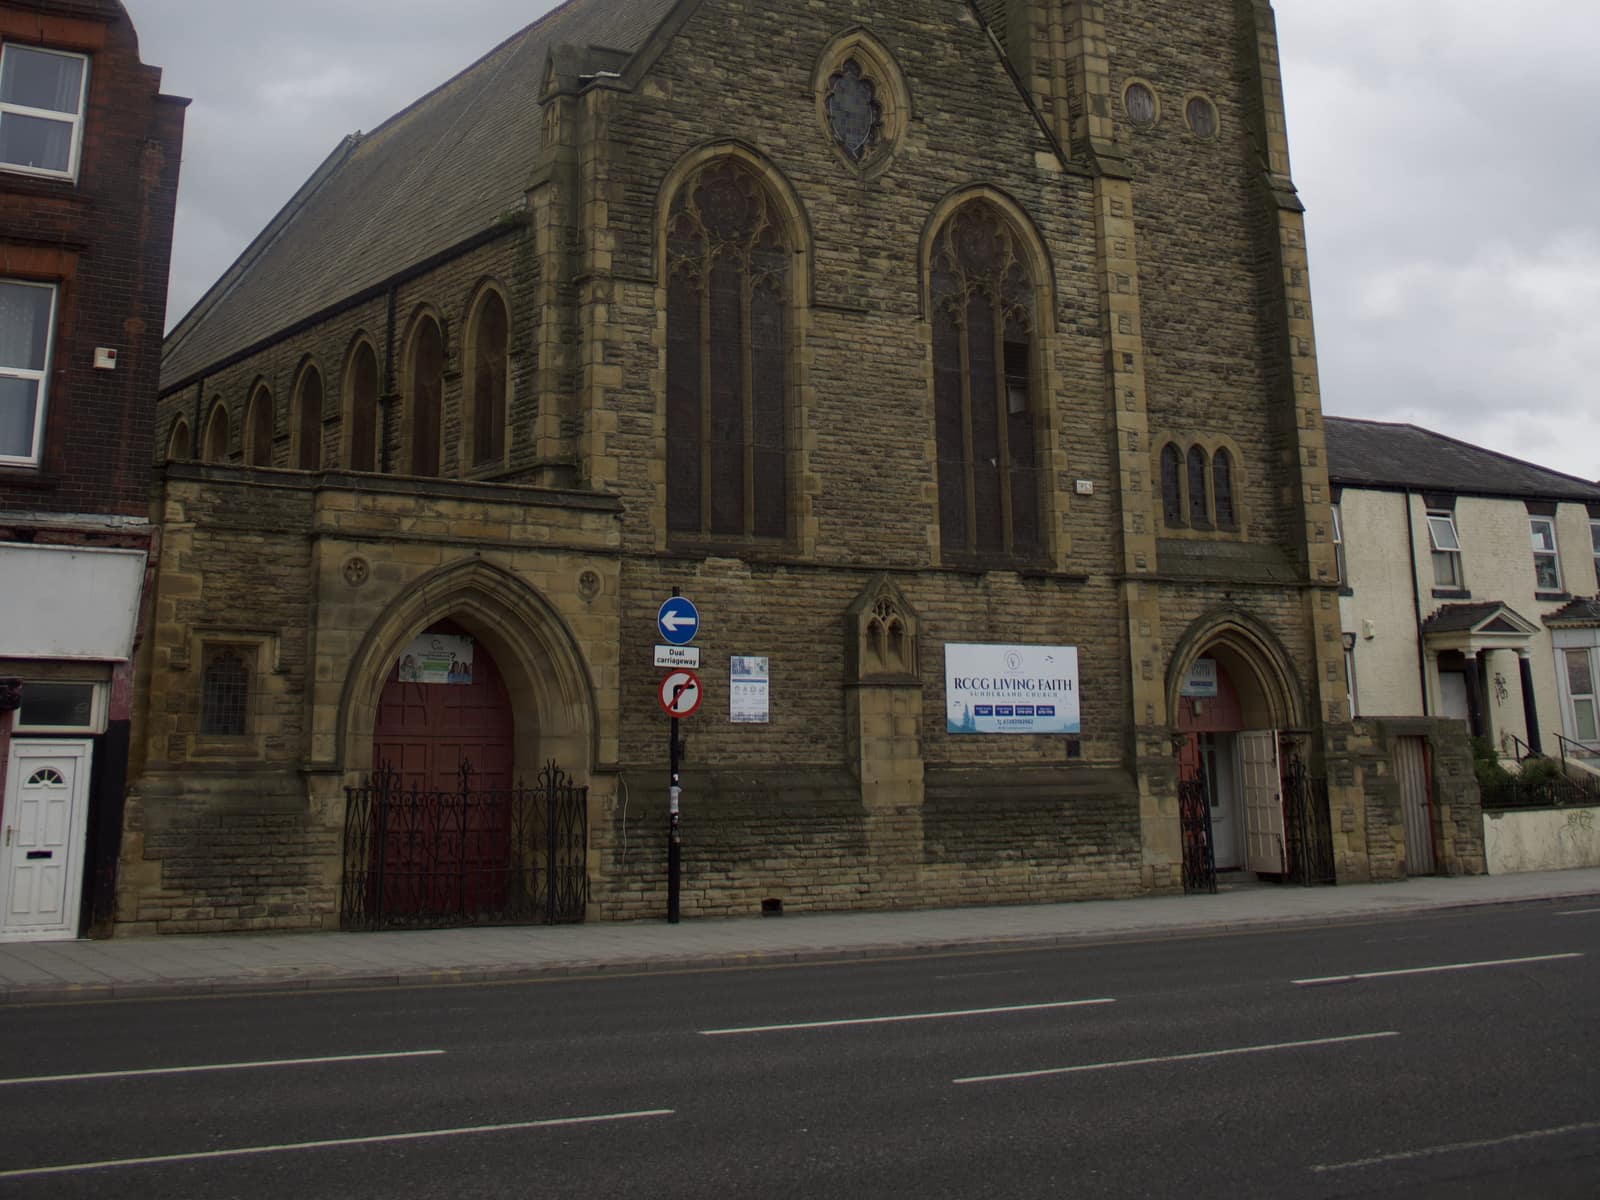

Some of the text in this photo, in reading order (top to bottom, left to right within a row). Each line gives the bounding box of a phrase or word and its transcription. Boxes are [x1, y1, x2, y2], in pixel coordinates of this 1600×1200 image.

[669, 648, 685, 656] Dual
[656, 657, 697, 666] carriageway
[954, 677, 1072, 691] RCCG LIVING FAITH
